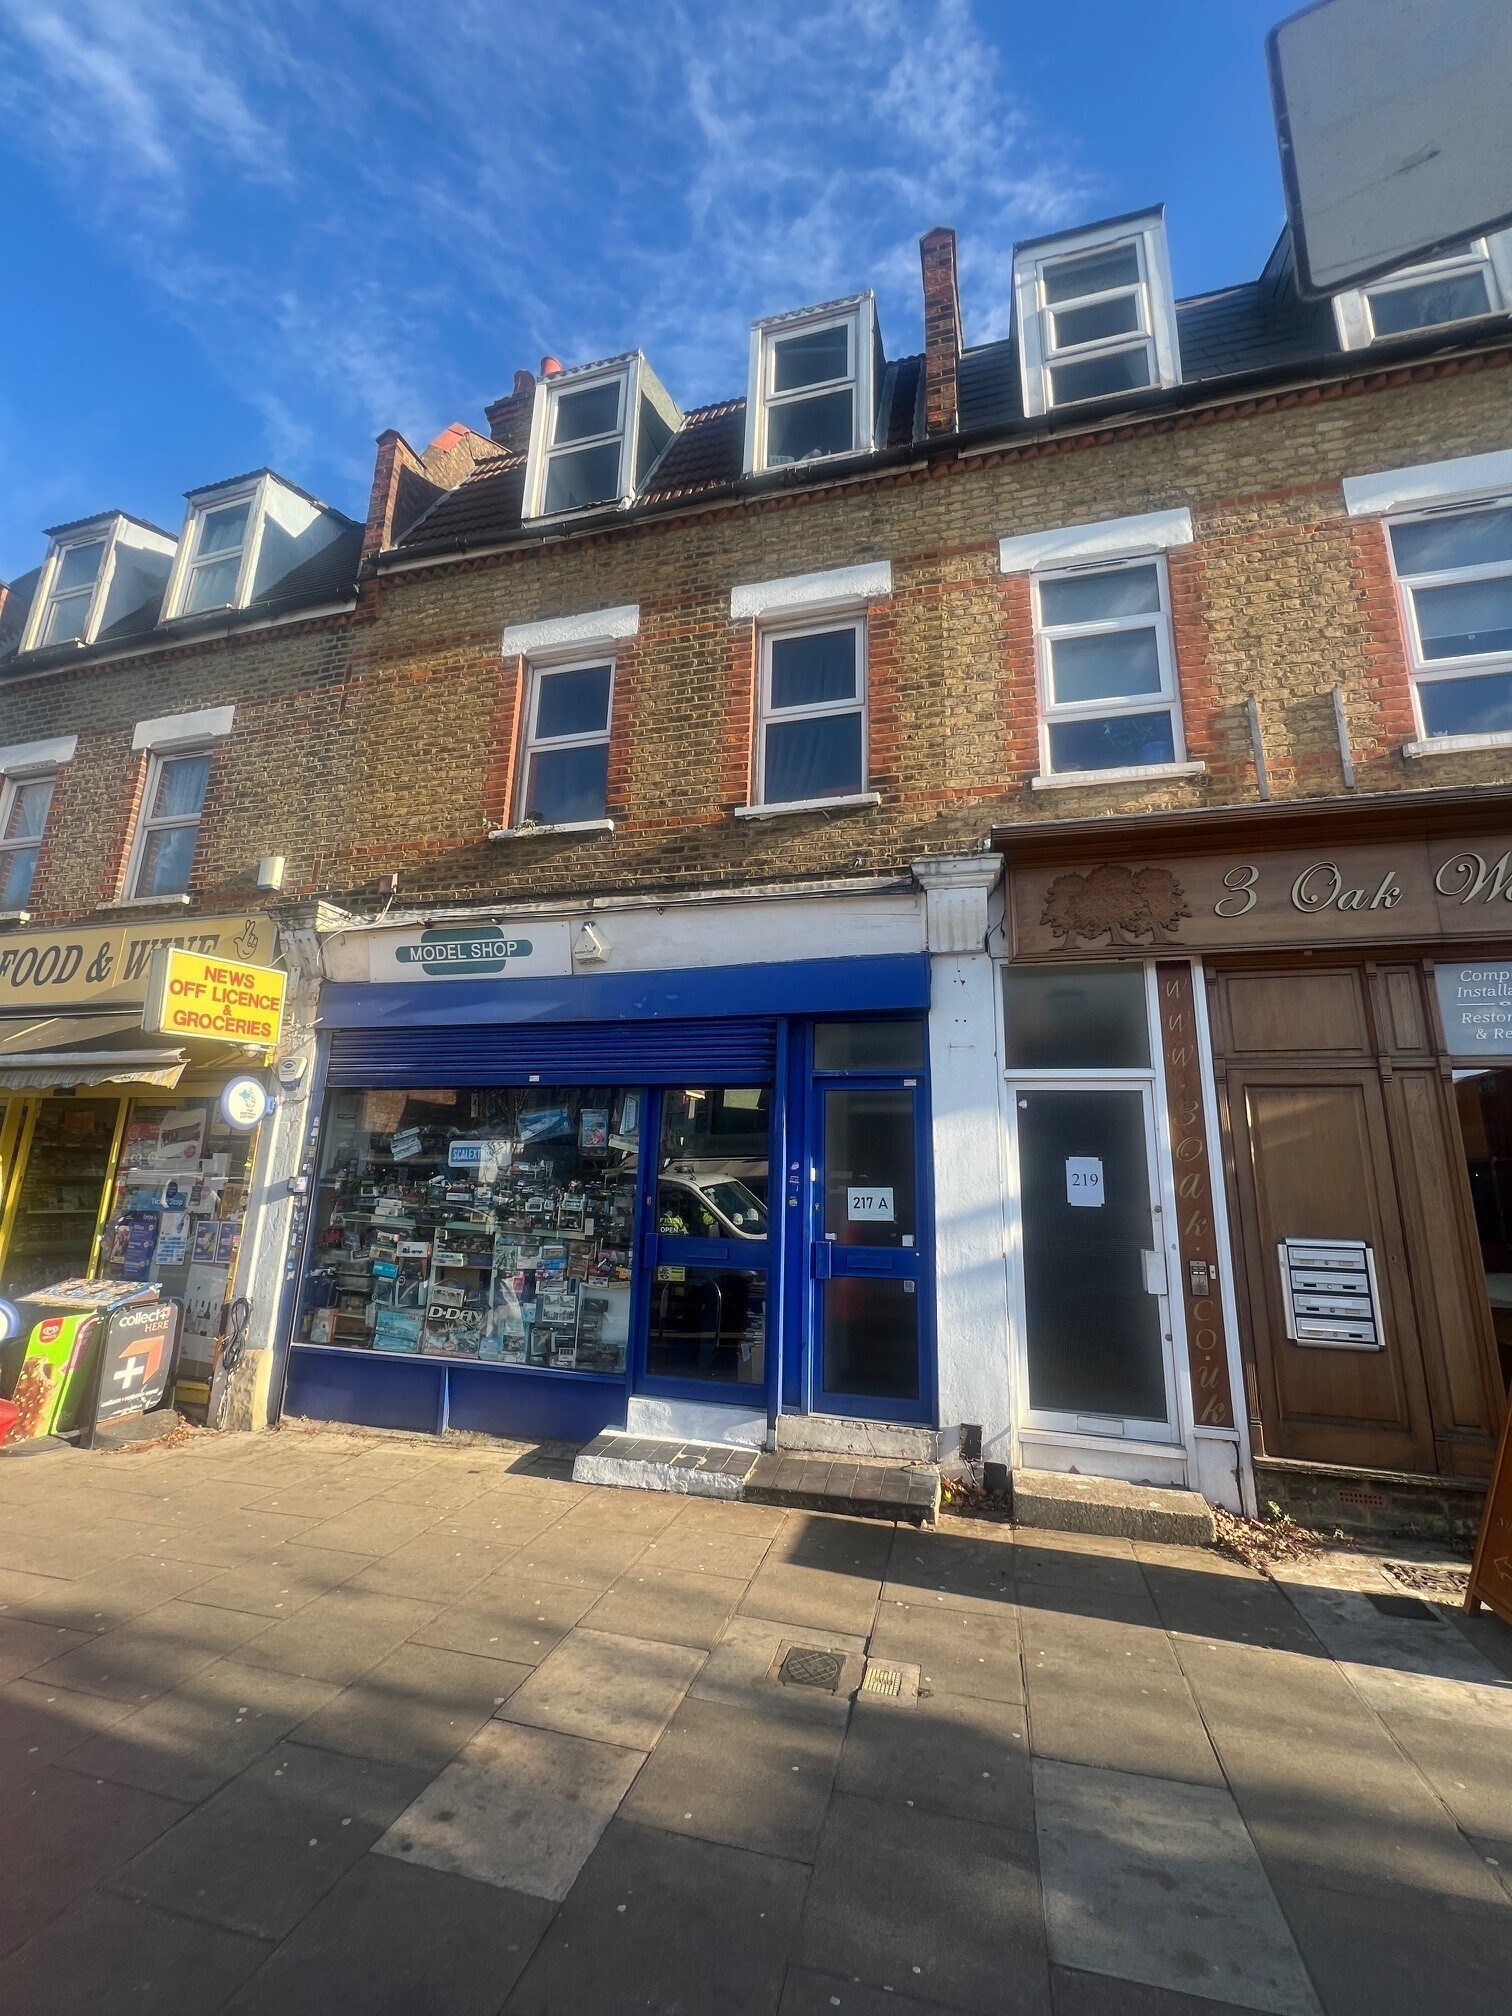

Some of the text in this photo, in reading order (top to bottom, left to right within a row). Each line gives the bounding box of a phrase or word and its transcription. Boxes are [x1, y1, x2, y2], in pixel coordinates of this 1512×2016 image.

[1214, 865, 1259, 917] 3
[1291, 861, 1403, 913] Oak
[410, 941, 518, 961] MODEL SHOP
[0, 944, 83, 987] FOOD
[85, 941, 114, 982] &
[204, 965, 255, 990] NEWS
[1460, 966, 1512, 983] Comp
[169, 978, 281, 1012] OFF LICENCE
[222, 1004, 232, 1017] &
[173, 1009, 272, 1038] GROCERIES
[1475, 1028, 1487, 1040] &
[1071, 1173, 1099, 1187] 219
[853, 1196, 888, 1209] 217 A
[660, 1226, 679, 1234] OPEN
[144, 1320, 170, 1333] HERE
